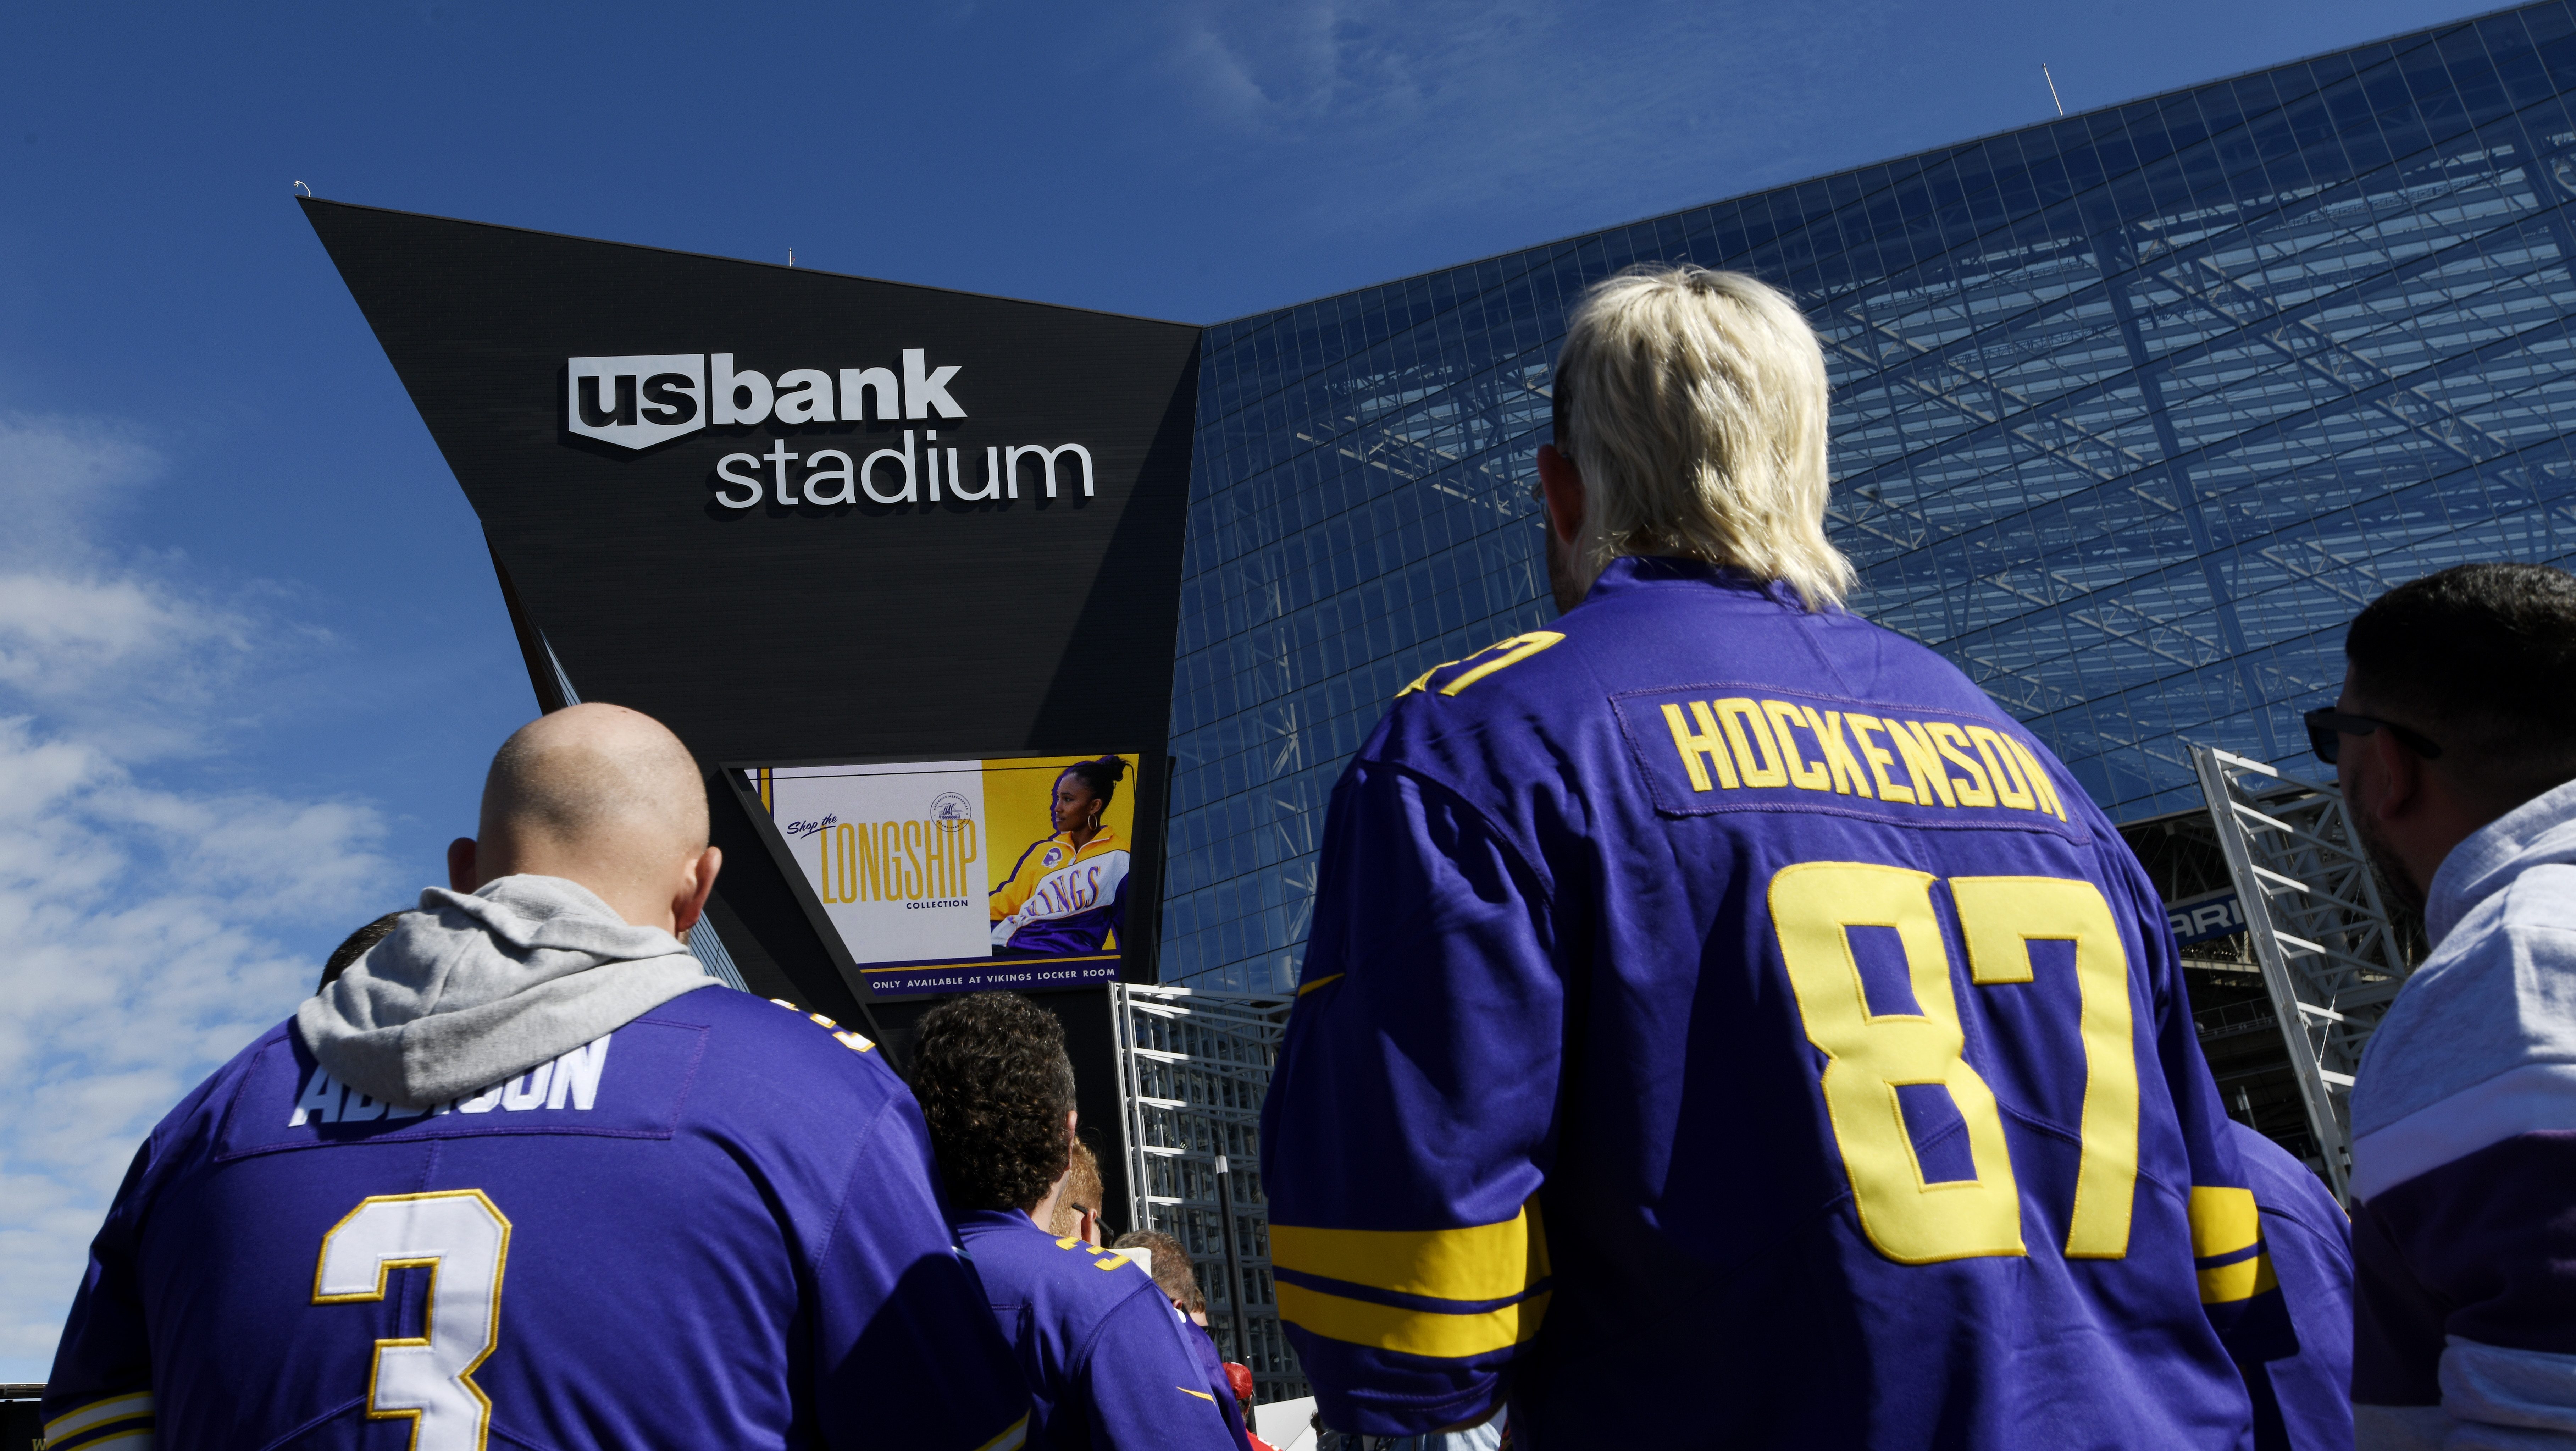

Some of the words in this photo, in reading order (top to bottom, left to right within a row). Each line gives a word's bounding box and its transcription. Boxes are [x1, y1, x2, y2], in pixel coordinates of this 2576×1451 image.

[716, 430, 1094, 509] stadium
[1661, 698, 2067, 822] HOCKENSON
[787, 820, 818, 834] Shop
[821, 813, 838, 826] the
[821, 817, 977, 904] LONGSHIP
[906, 900, 968, 909] COLLECTION
[872, 981, 901, 989] ONLY
[907, 977, 963, 987] AVAILABLE
[987, 973, 1032, 982] VIKINGS
[1038, 971, 1077, 980] LOCKER
[1083, 969, 1115, 977] ROOM
[1767, 861, 2139, 1264] 87
[312, 1188, 512, 1451] 3
